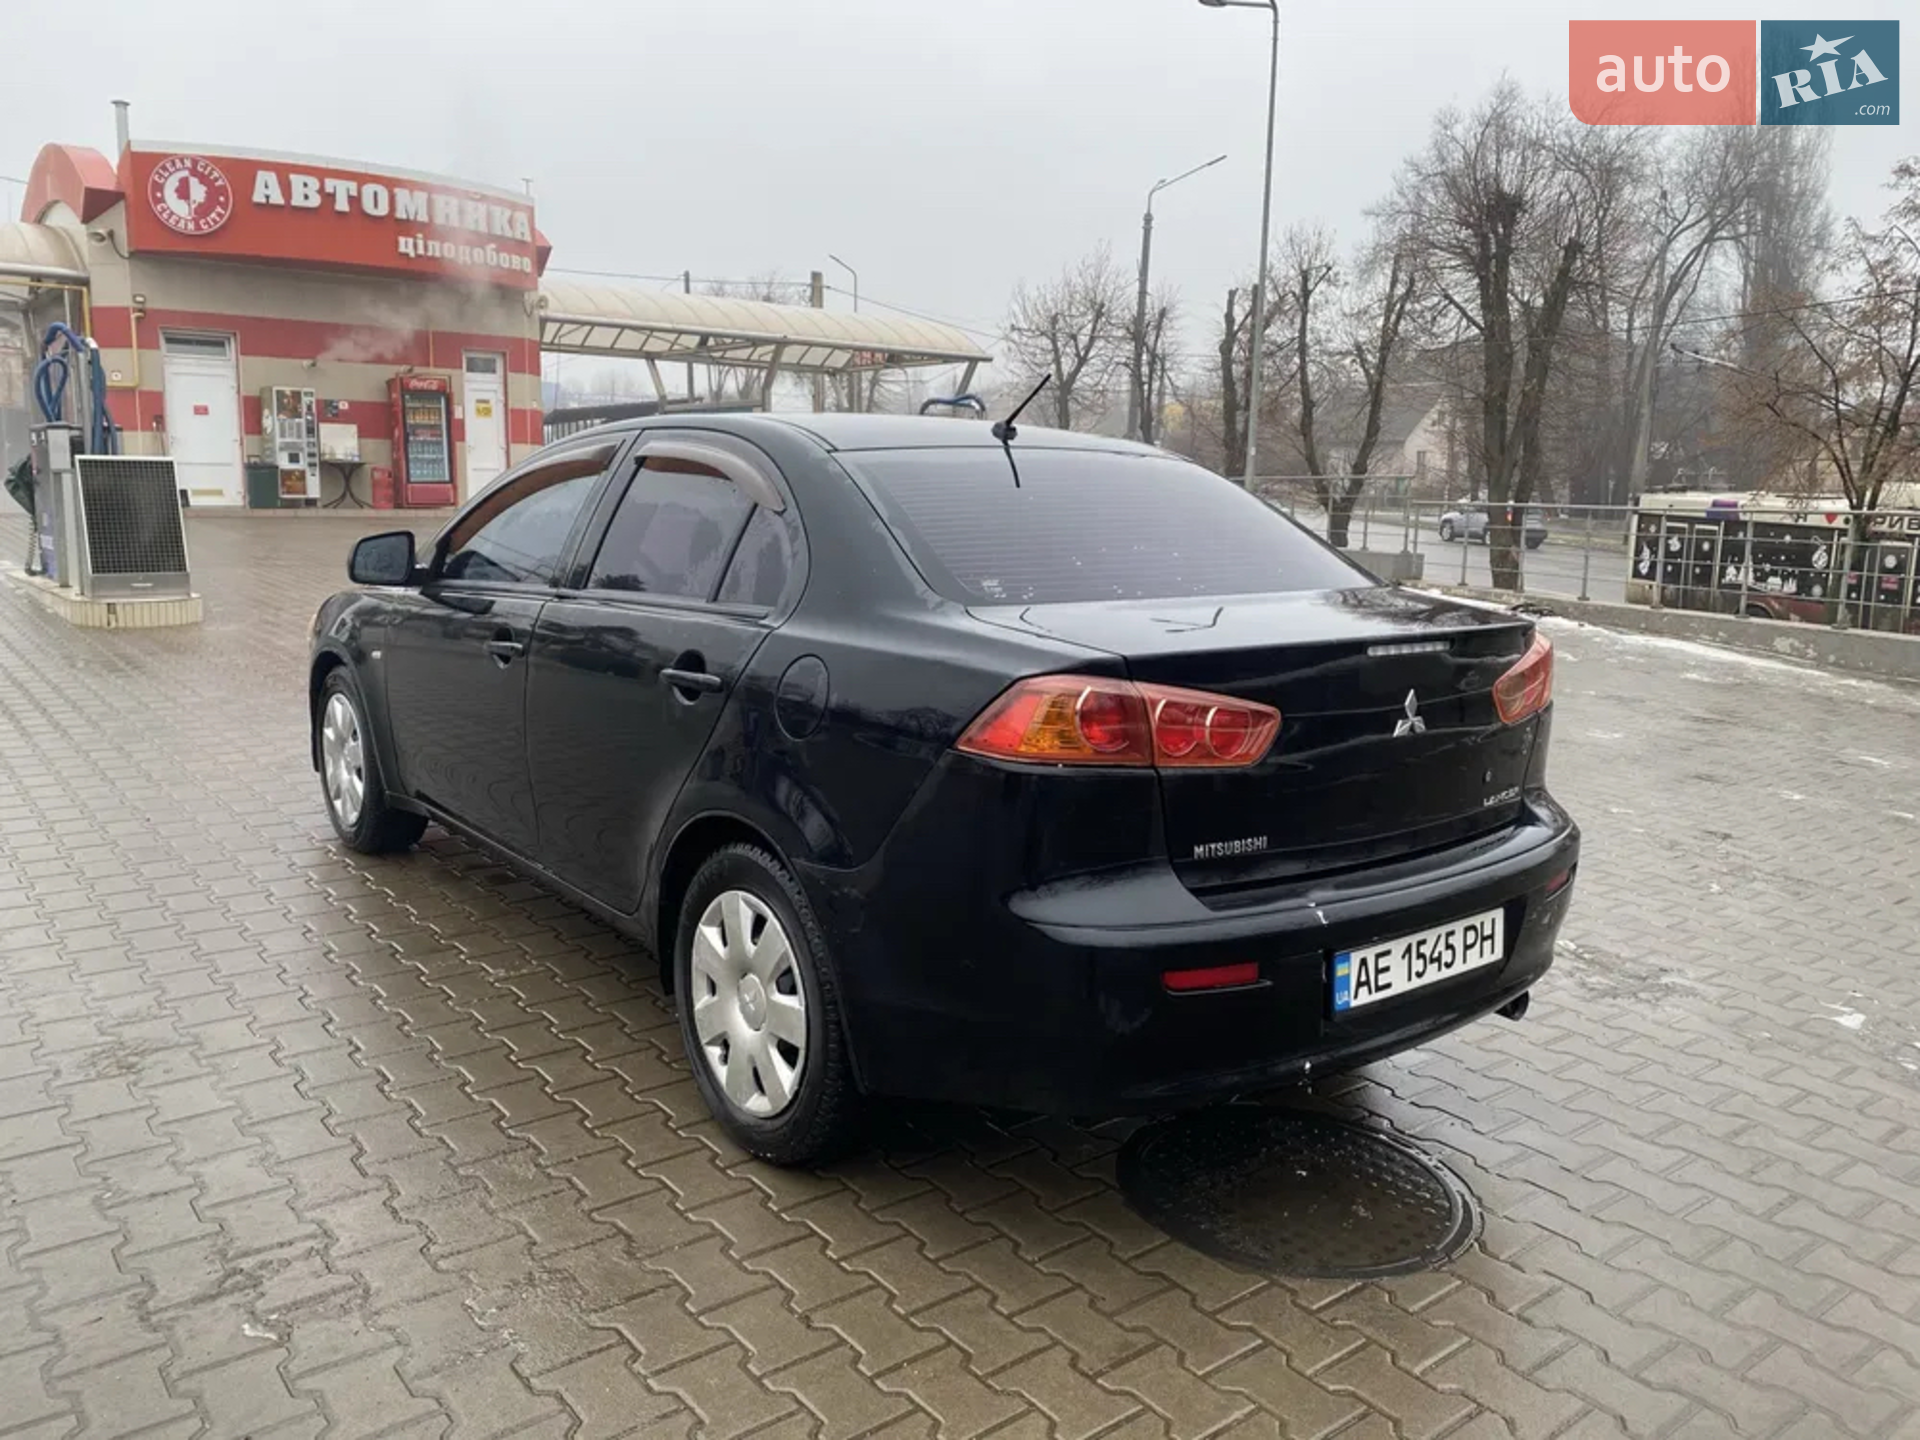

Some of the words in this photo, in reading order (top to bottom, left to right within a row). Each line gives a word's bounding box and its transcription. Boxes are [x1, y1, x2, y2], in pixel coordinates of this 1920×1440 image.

[153, 157, 192, 184] CLEAN
[197, 159, 226, 187] CITY
[156, 202, 195, 231] CLEAN
[199, 205, 226, 230] CITY
[252, 170, 532, 243] АВТОМИЙКА
[398, 233, 532, 274] цілодобово
[1193, 835, 1268, 860] MITSUBISHI
[1353, 949, 1392, 1001] AE
[1401, 929, 1456, 982] 1545
[1463, 917, 1496, 964] PH
